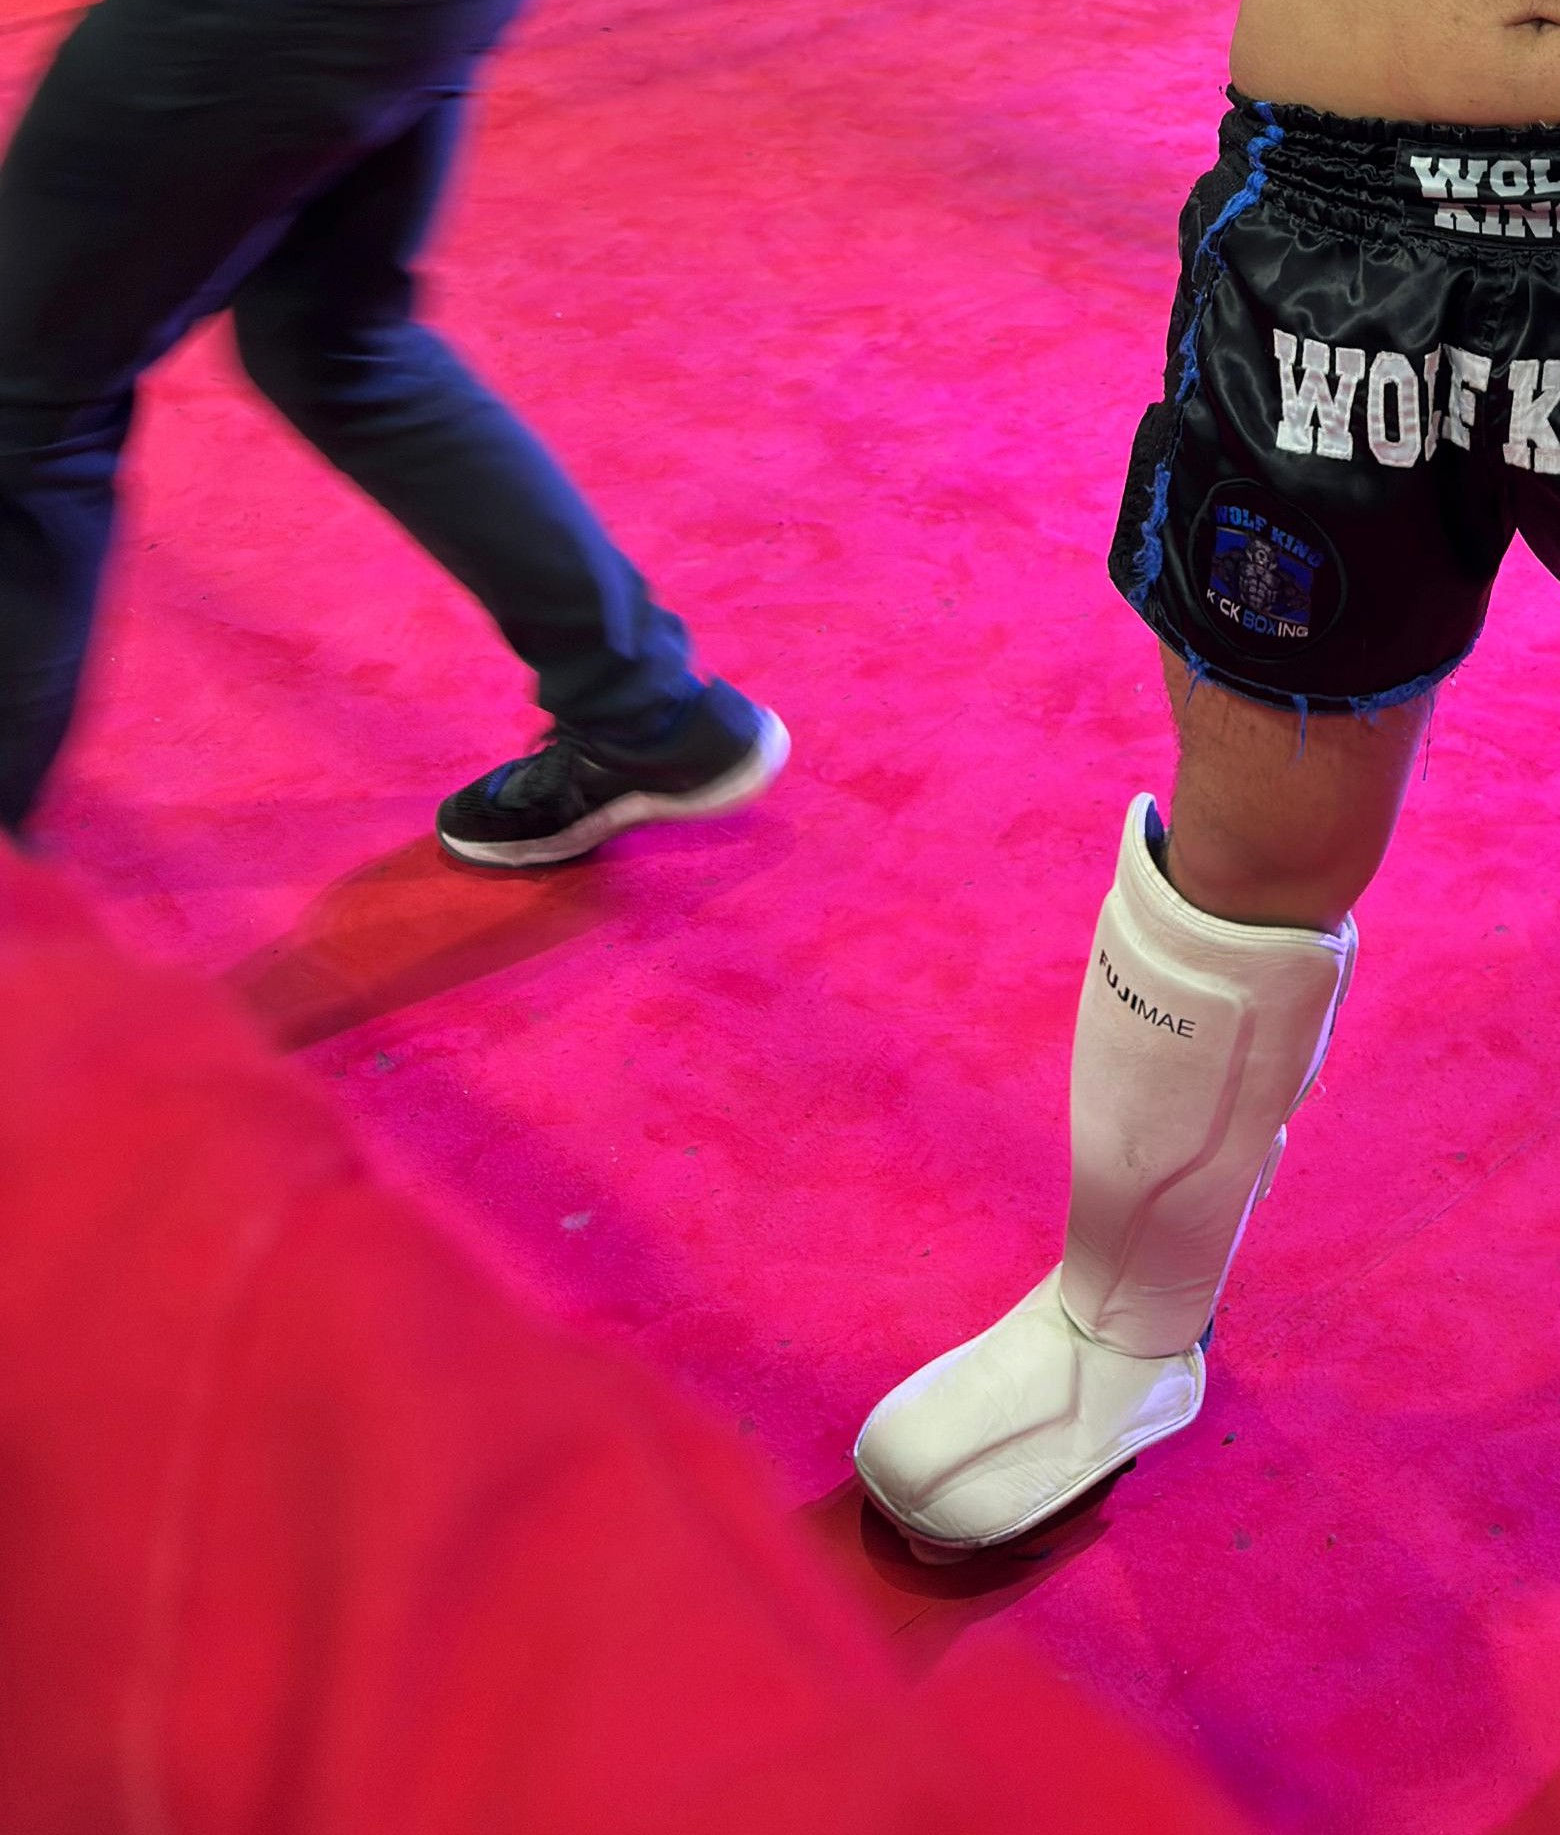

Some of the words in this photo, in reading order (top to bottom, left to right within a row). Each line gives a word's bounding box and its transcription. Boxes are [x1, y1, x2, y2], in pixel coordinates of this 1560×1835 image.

[1215, 504, 1269, 533] WOLF
[1205, 587, 1241, 623] KCK
[1099, 948, 1197, 1039] FUJIMAE
